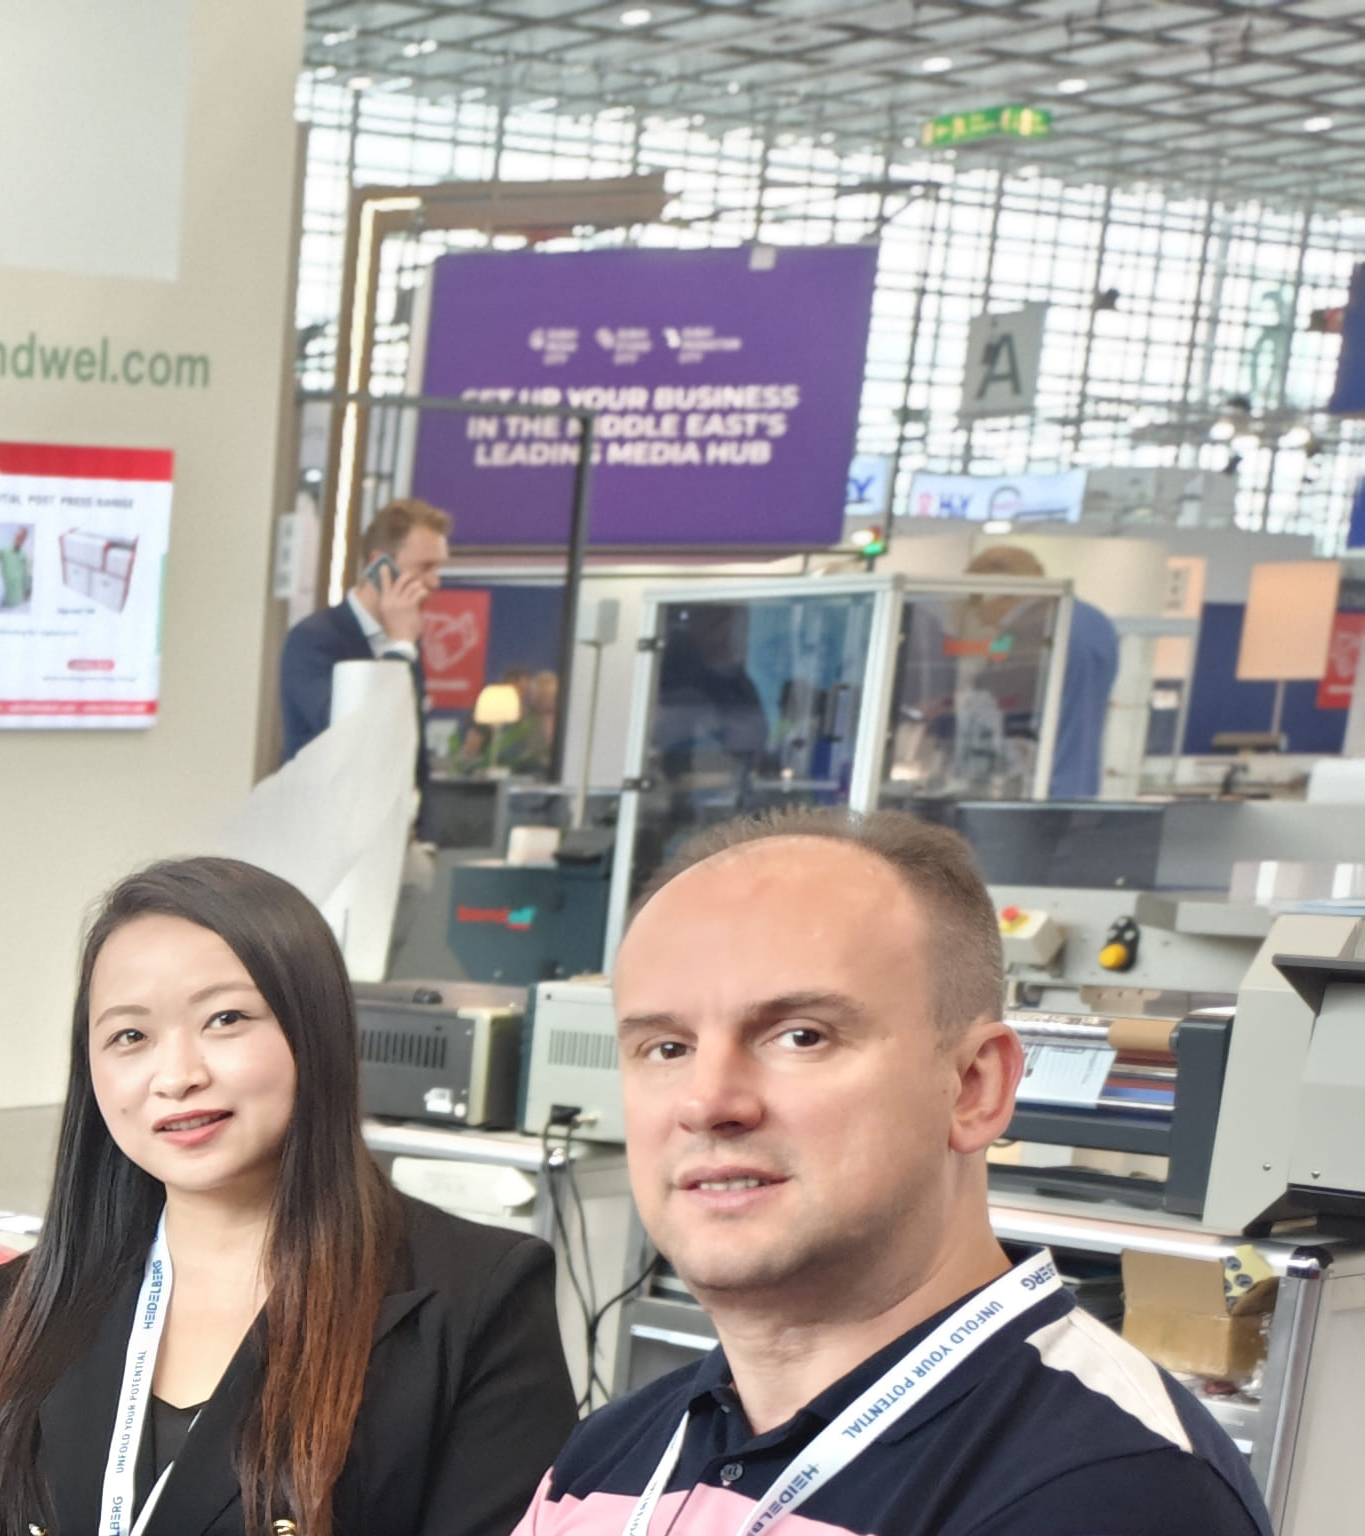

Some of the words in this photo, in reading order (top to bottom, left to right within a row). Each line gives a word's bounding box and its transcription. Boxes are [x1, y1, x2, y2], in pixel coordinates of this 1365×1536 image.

[567, 386, 650, 411] YOUR
[653, 384, 801, 411] BUSINESS
[467, 415, 499, 439] IN
[505, 415, 561, 438] THE
[686, 412, 788, 438] EAST'S
[606, 441, 701, 466] MEDIA
[707, 440, 771, 464] HUB
[143, 1259, 164, 1330] HEIDELBERG
[950, 1300, 1004, 1346] UNFOLD
[128, 1350, 148, 1404] POTENTIAL
[911, 1344, 953, 1379] YOUR
[125, 1404, 137, 1431] YOUR
[841, 1378, 915, 1440] POTENTIAL
[116, 1433, 131, 1474] UNFOLD
